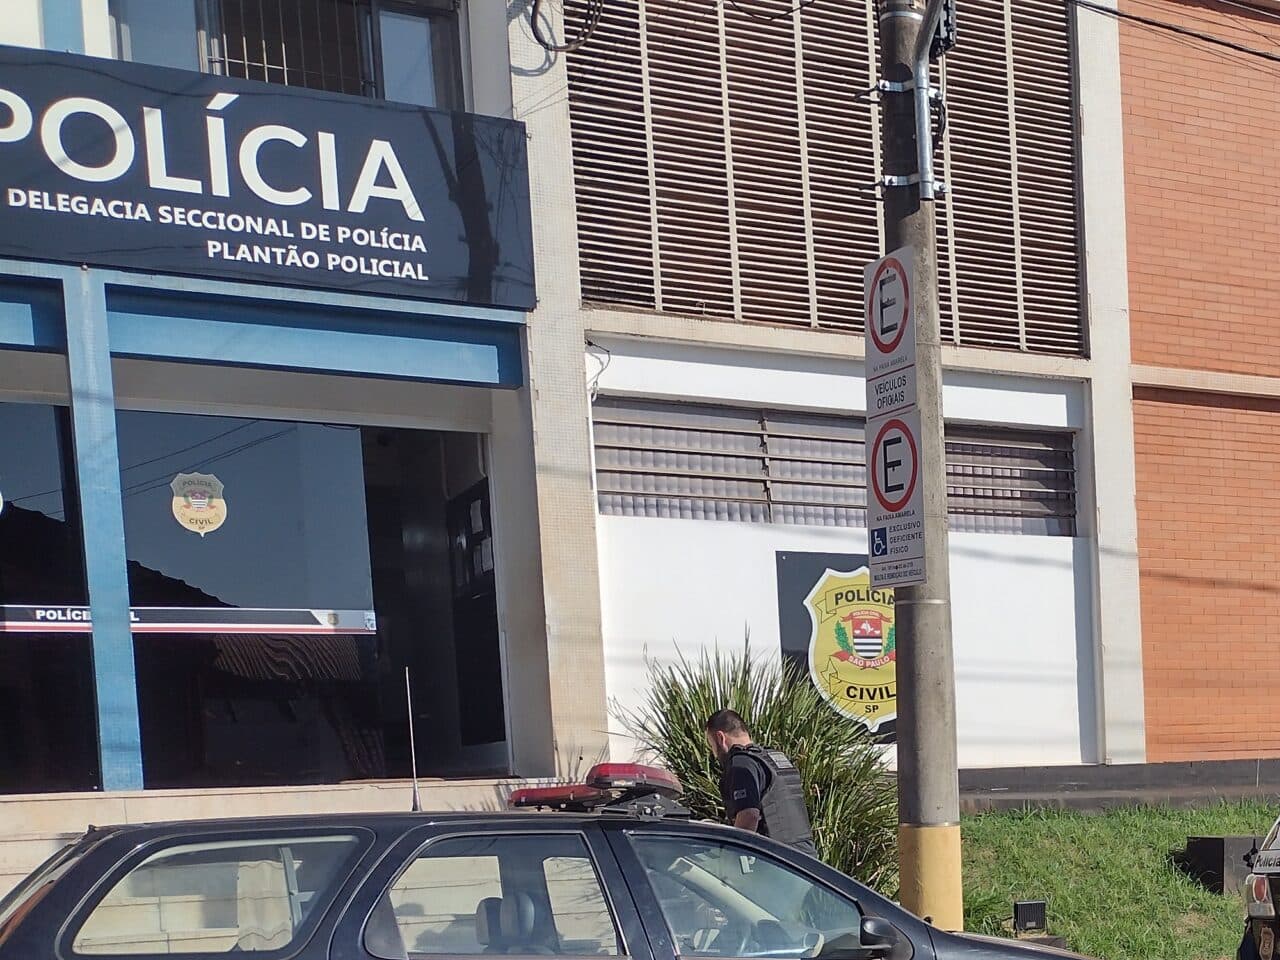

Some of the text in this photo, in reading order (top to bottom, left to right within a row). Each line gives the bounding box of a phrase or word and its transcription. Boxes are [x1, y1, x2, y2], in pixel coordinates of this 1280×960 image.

[7, 188, 427, 253] DELEGACIA SECCIONAL DE POLÍCIA
[207, 240, 429, 281] PLANTÃO POLICIAL
[879, 273, 898, 336] E
[883, 436, 905, 493] E
[889, 520, 921, 533] EXCLUSIVO
[890, 532, 923, 544] DEFICIENTE
[865, 656, 890, 668] PAULO
[846, 685, 896, 701] CIVIL
[865, 704, 879, 713] SP
